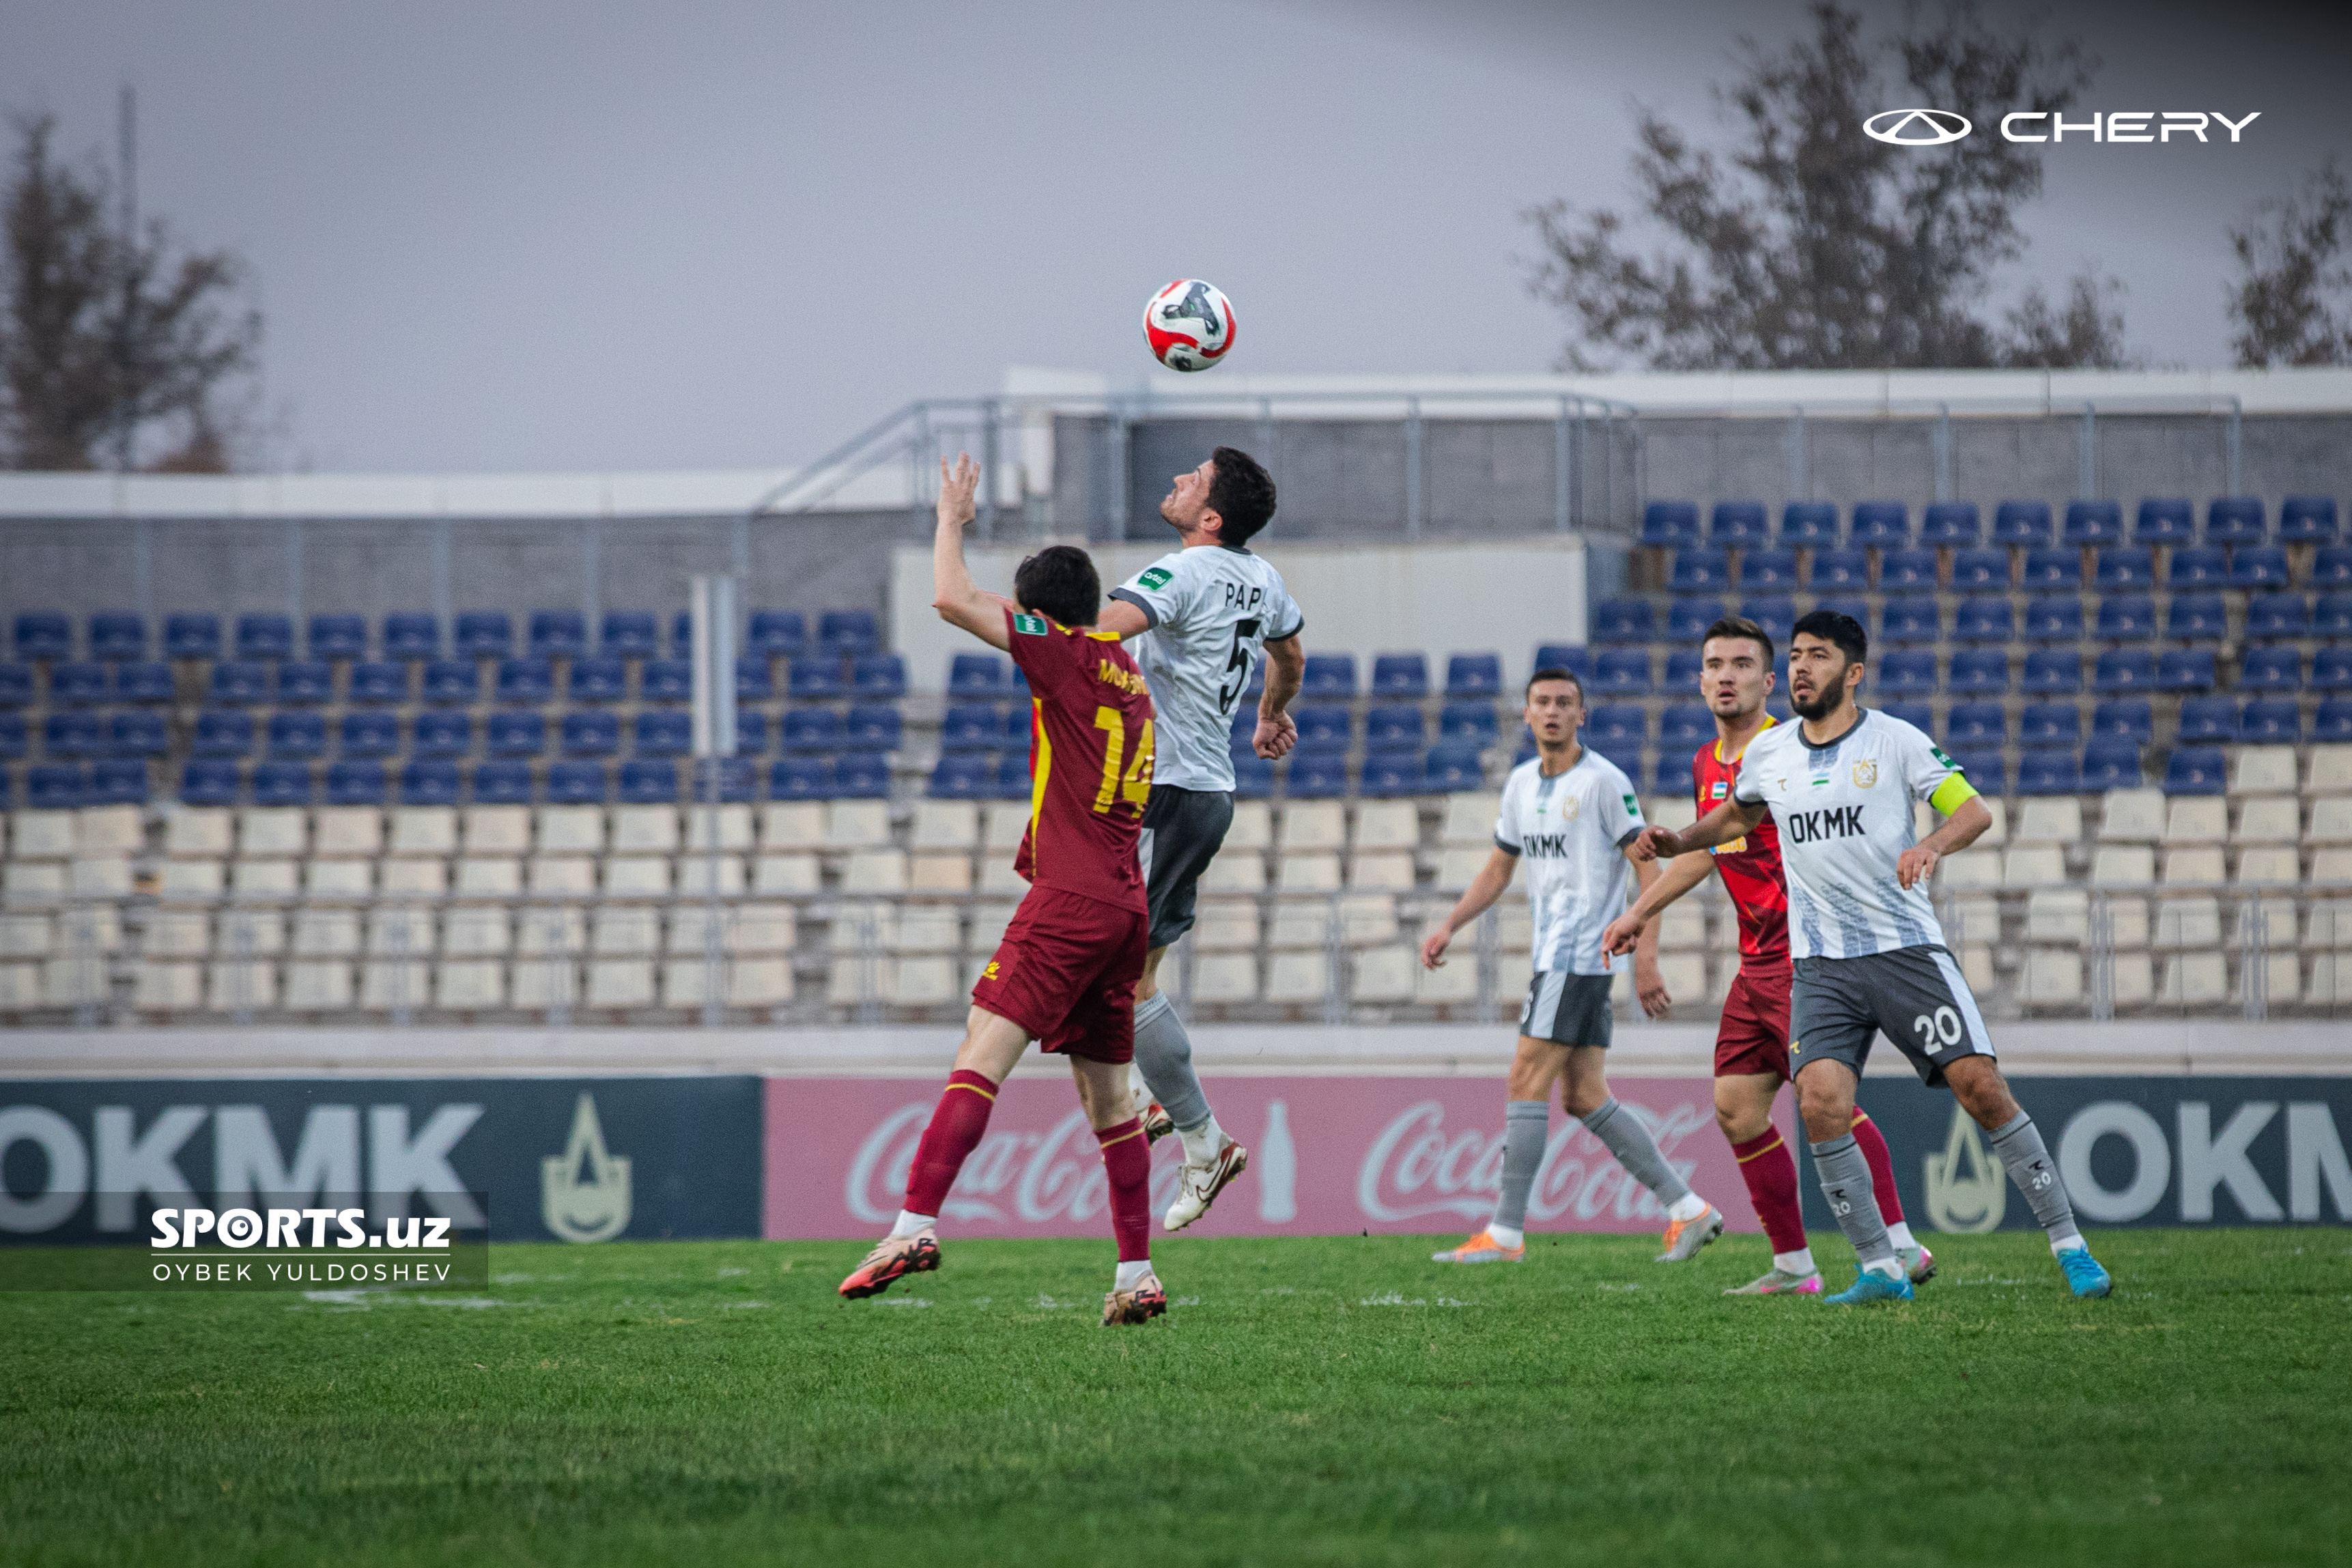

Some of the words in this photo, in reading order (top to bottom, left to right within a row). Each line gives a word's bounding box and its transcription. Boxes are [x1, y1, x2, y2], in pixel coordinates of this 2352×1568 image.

[1144, 571, 1166, 585] artel
[1219, 619, 1261, 715] 5
[1093, 705, 1155, 818] 14
[1789, 805, 1866, 844] OKMK
[1523, 833, 1568, 859] OKMK
[1914, 1006, 1961, 1055] 20
[0, 1104, 487, 1233] OKMK
[2032, 1171, 2052, 1191] 20
[1831, 1200, 1851, 1217] 20
